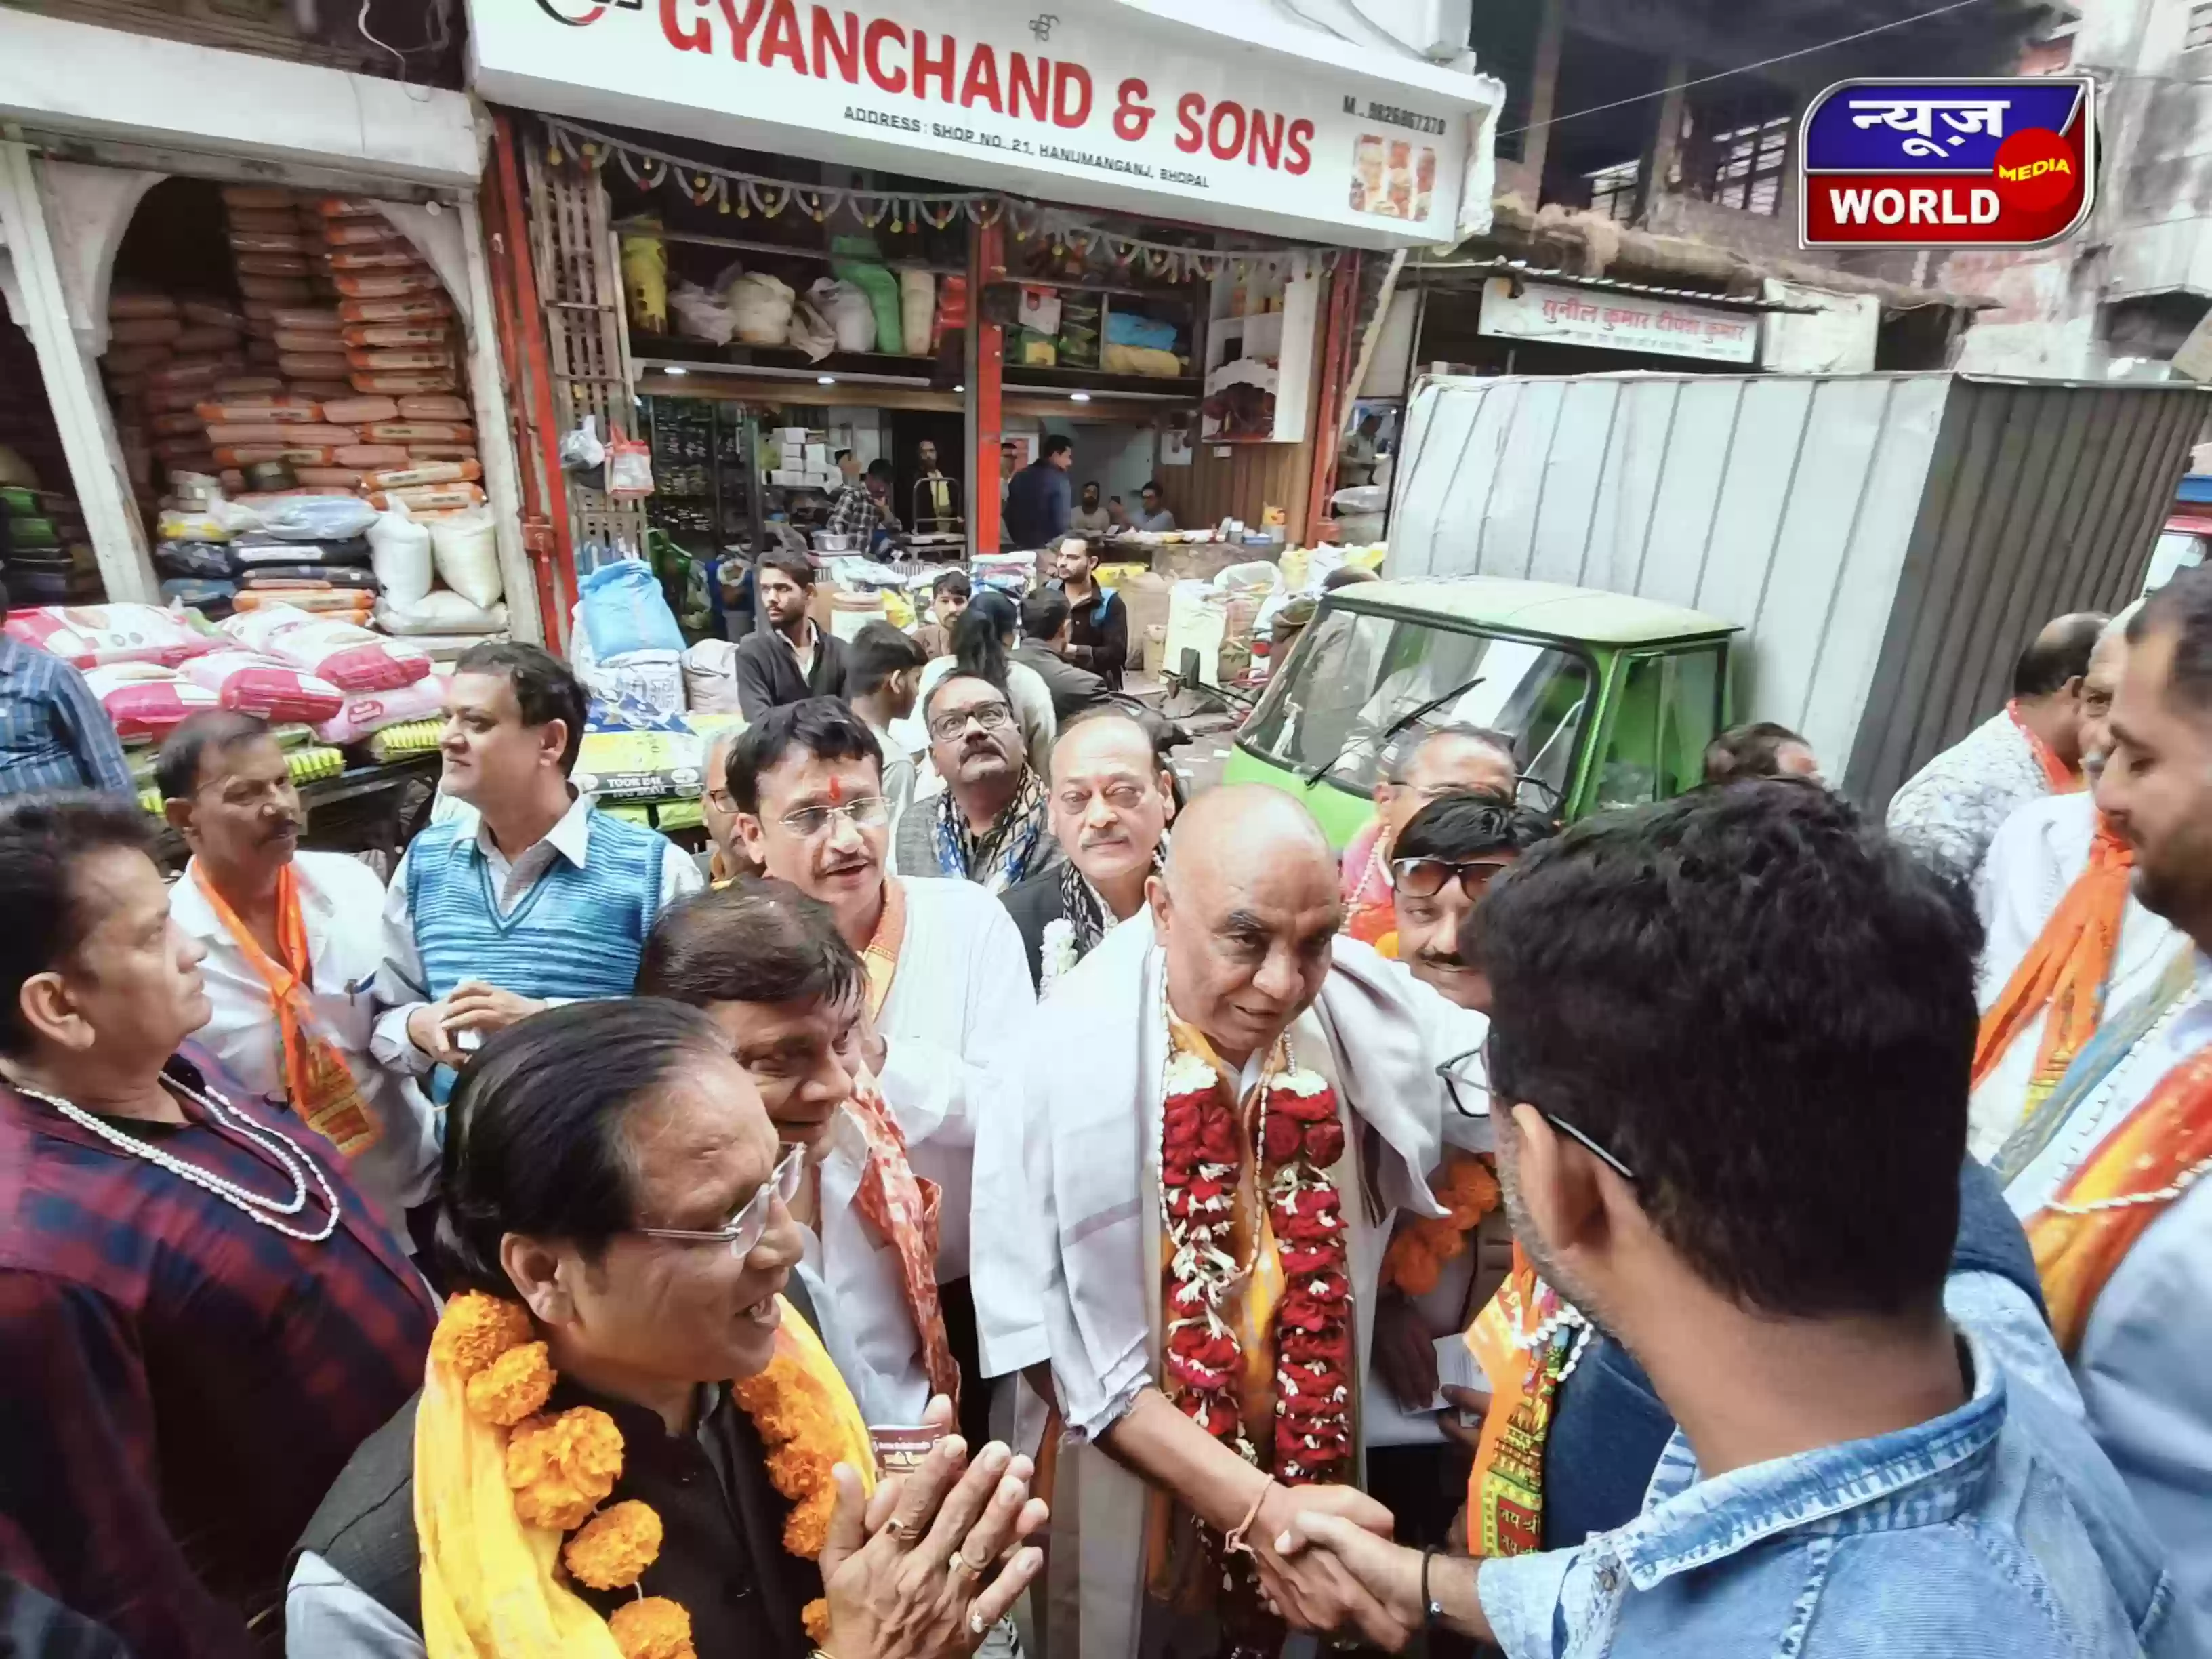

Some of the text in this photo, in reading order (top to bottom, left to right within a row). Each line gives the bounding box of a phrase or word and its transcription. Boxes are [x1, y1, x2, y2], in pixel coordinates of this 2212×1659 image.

[659, 0, 1315, 176] GYANCHAND & SONS
[932, 122, 974, 143] SHOP
[1160, 167, 1210, 188] BHOPAL
[1542, 297, 1599, 324] सुनील
[1601, 307, 1651, 331] कुमार
